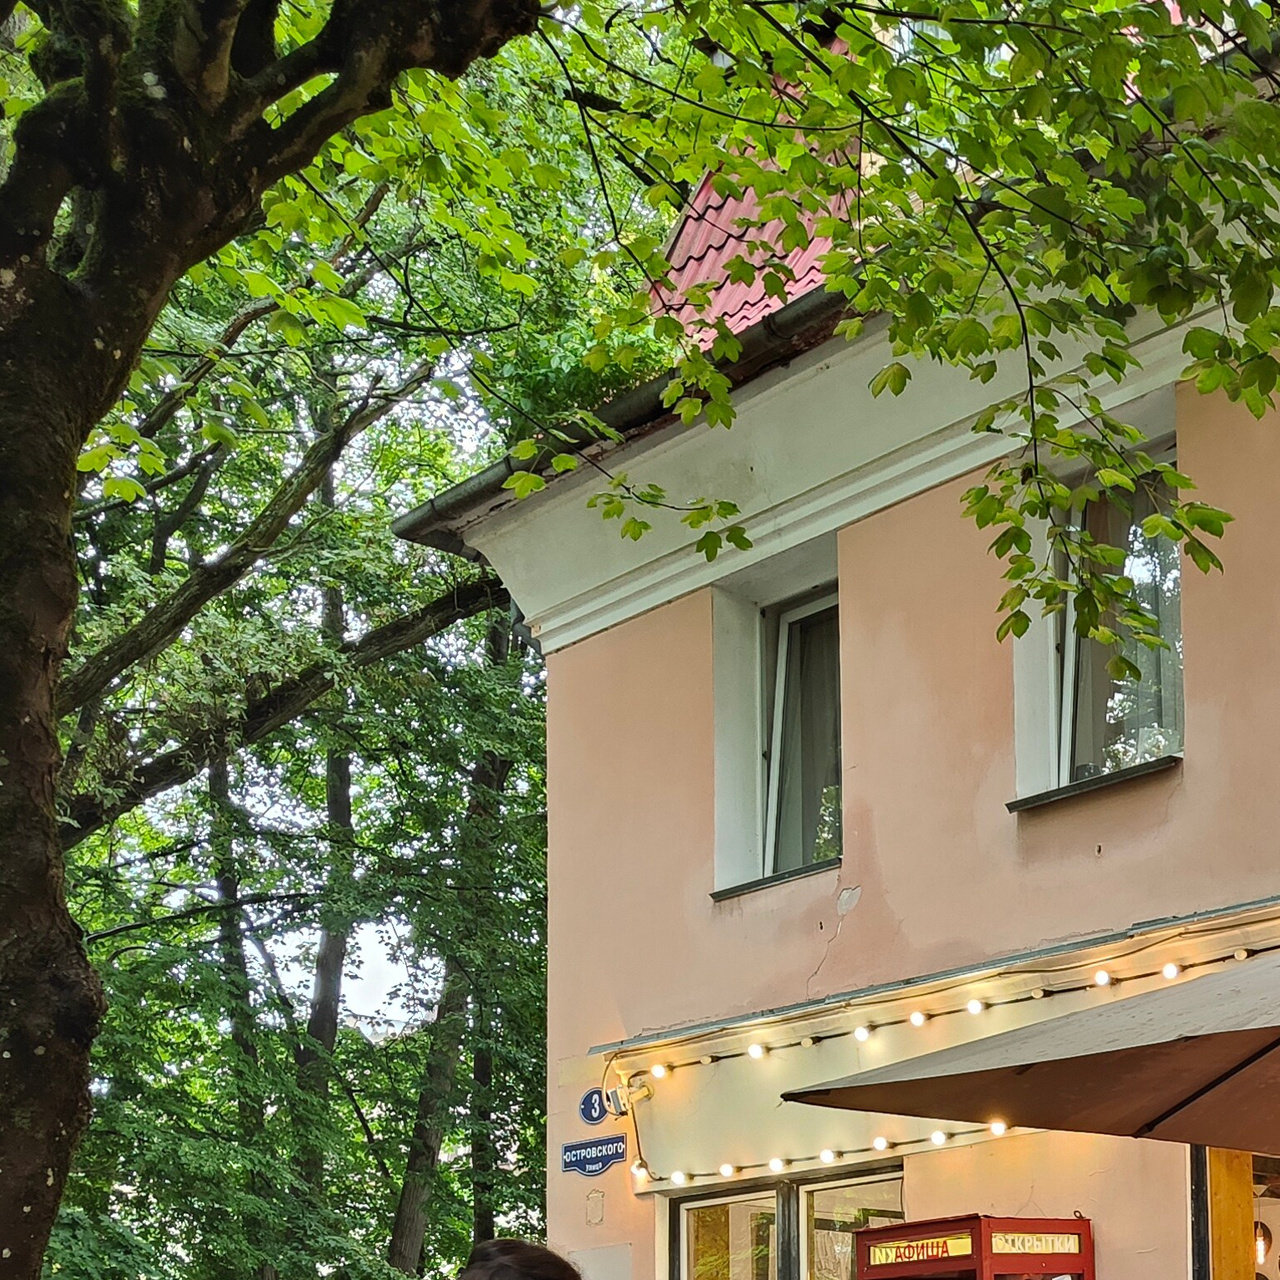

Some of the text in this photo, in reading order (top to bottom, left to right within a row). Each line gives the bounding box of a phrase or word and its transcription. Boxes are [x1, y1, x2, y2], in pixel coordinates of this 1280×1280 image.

[591, 1094, 600, 1118] 3
[565, 1142, 624, 1162] ОСТРОВСКОГО
[894, 1240, 950, 1262] АФИША
[993, 1235, 1076, 1253] ОТКРЫТКИ
